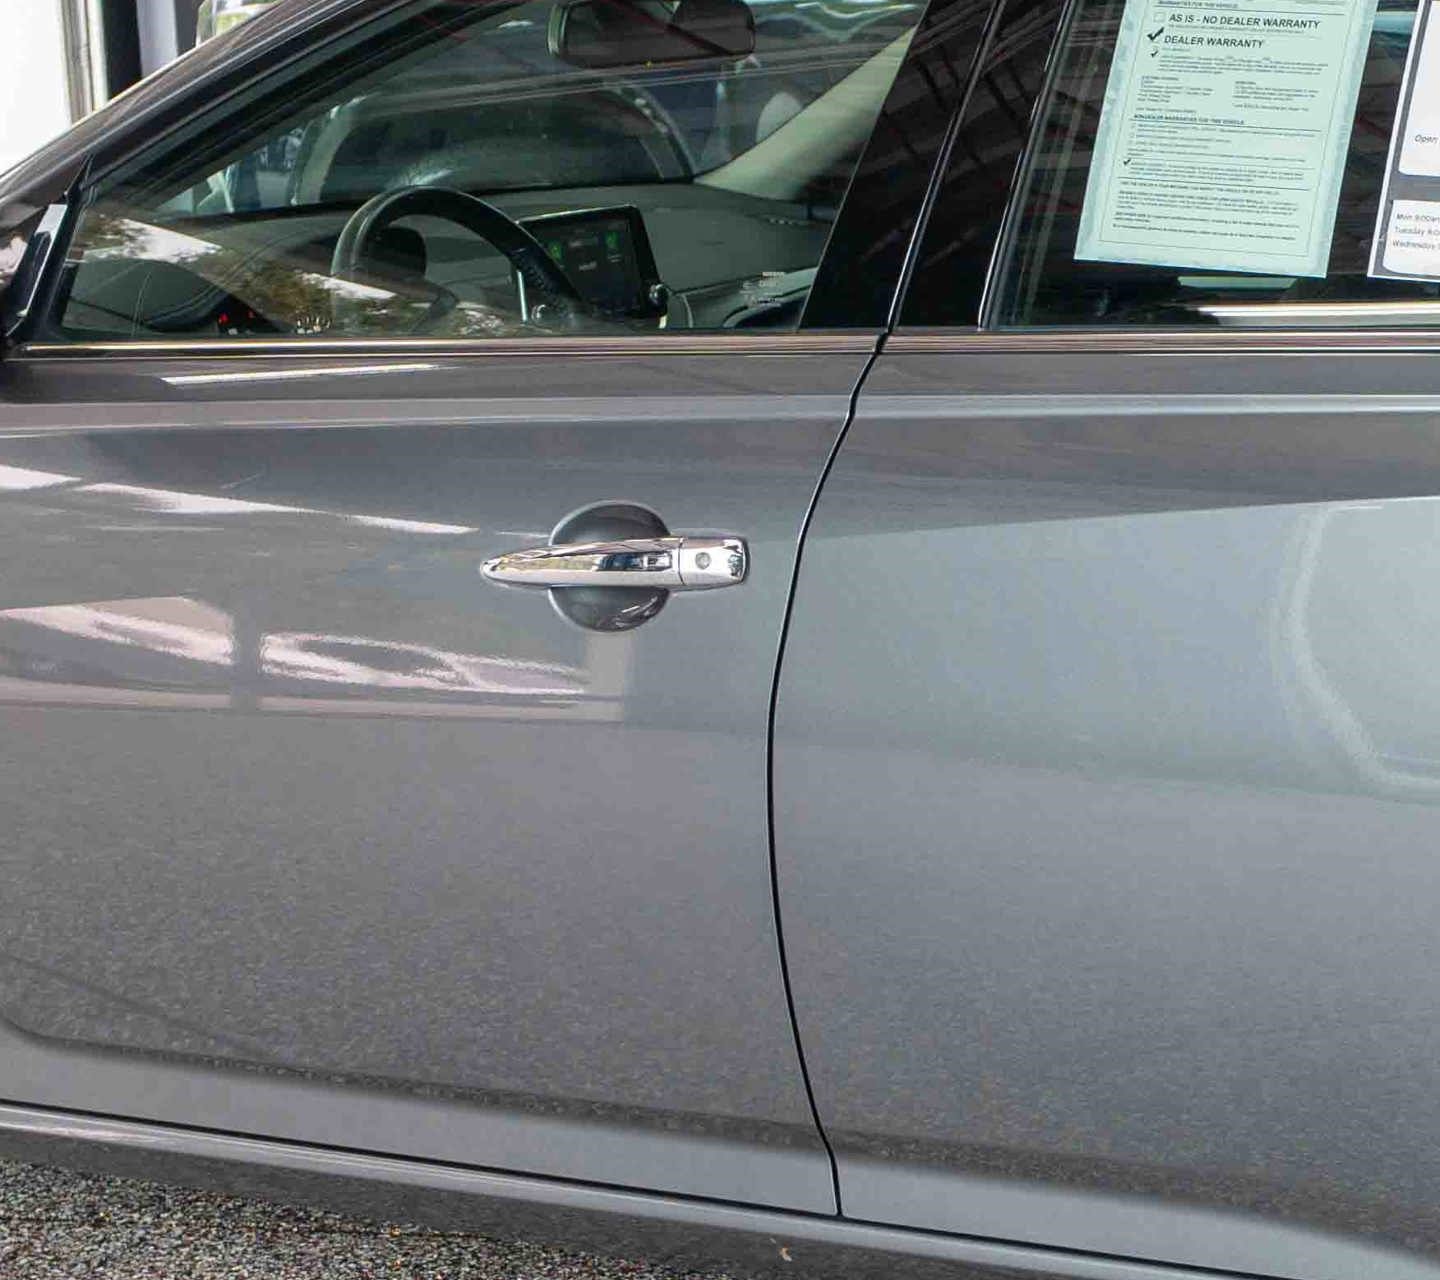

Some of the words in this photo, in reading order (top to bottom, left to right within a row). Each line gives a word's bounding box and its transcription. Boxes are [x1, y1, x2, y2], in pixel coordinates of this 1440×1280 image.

[1169, 13, 1184, 23] AS
[1185, 14, 1195, 23] IS
[1203, 15, 1217, 25] NO
[1218, 17, 1261, 27] DEALER
[1263, 19, 1321, 30] WARRANTY
[1164, 35, 1205, 45] DEALER
[1206, 38, 1264, 48] WARRANTY
[1414, 134, 1438, 145] Open
